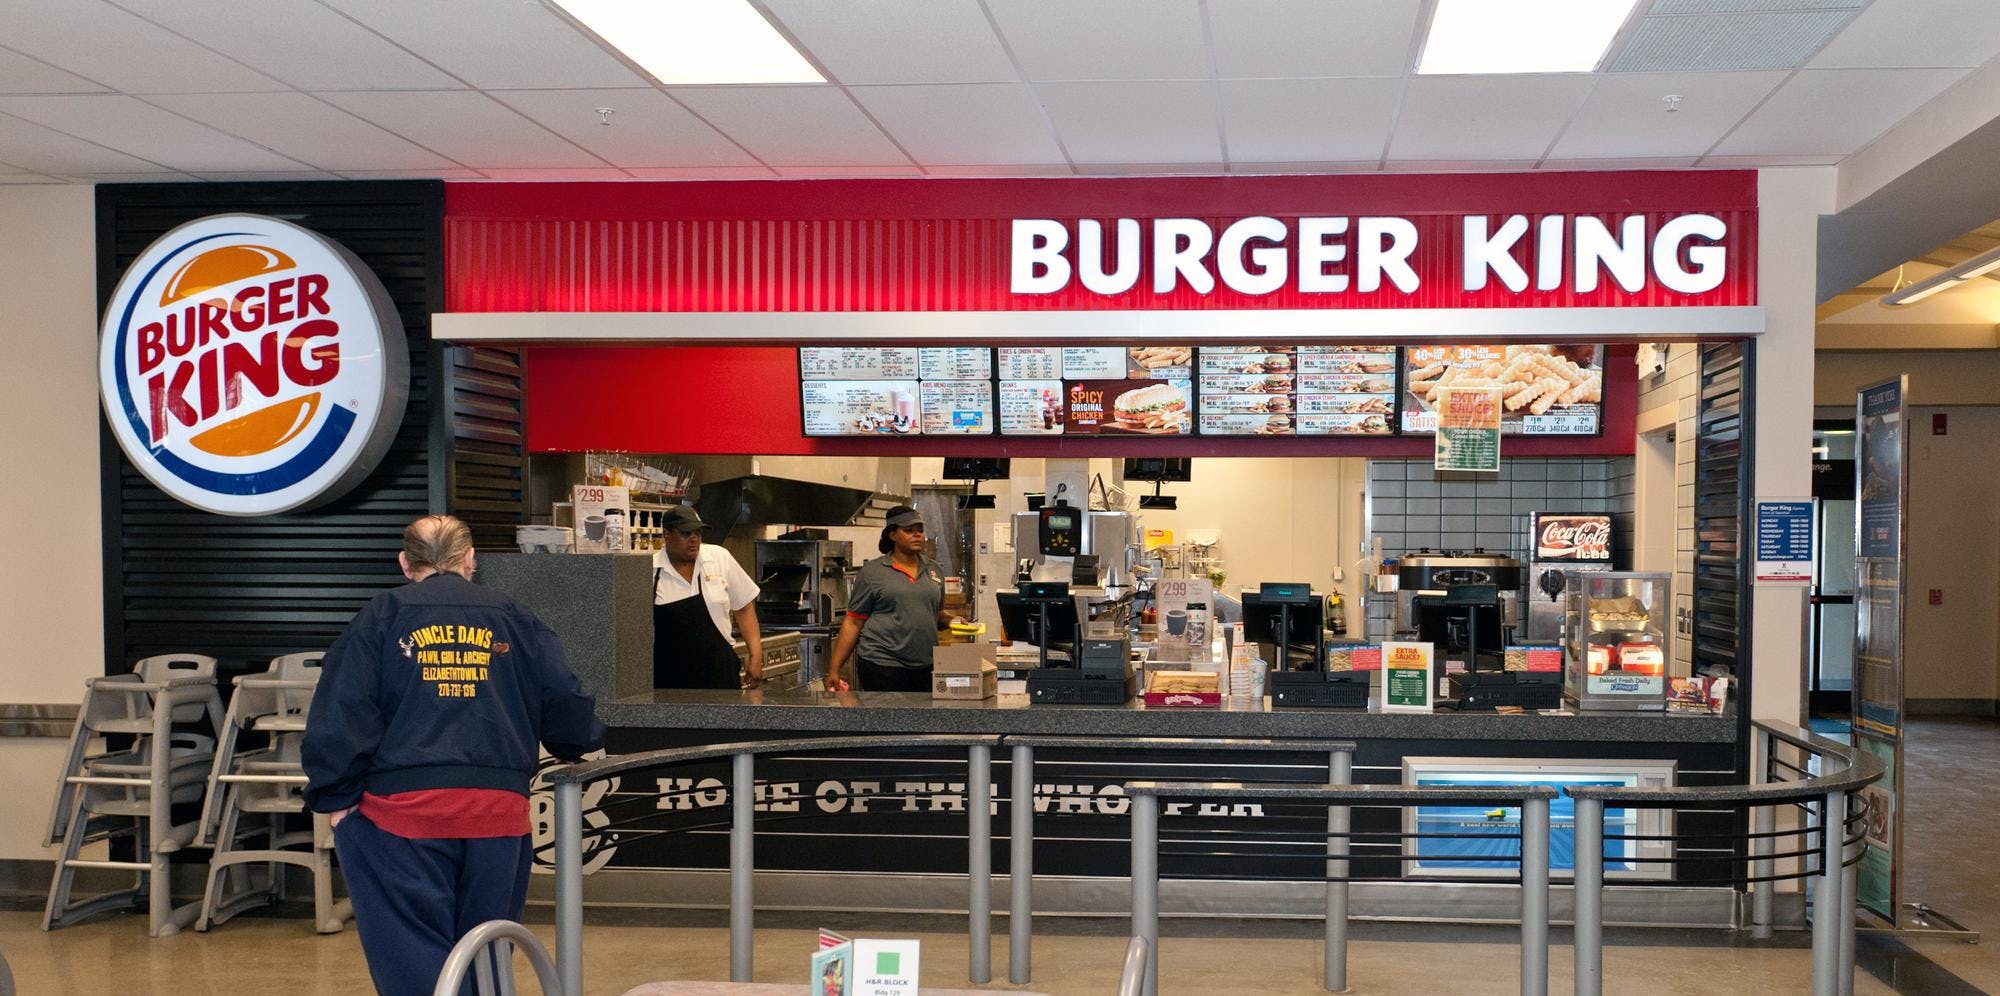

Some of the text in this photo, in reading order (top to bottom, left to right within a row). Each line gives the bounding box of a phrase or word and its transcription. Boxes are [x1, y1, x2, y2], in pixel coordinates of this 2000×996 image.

[1010, 213, 1728, 296] BURGER KING
[137, 273, 330, 376] BURGER
[1200, 355, 1205, 363] 2
[1299, 355, 1303, 363] 7
[147, 319, 340, 444] KING
[1200, 376, 1205, 384] 3
[1298, 375, 1303, 384] 8
[1071, 391, 1104, 404] SPICY
[1200, 396, 1206, 404] 4
[1298, 395, 1303, 404] 9
[1451, 392, 1488, 402] EXTRA
[1071, 403, 1104, 411] ORIGINAL
[1071, 411, 1104, 420] CHICKEN
[1201, 415, 1206, 424] 5
[577, 488, 604, 502] $2.99
[1542, 521, 1611, 546] Coca-Cola
[411, 625, 493, 649] UNCLE DAN'S
[417, 650, 491, 666] PAWN, GUN & ARCHERY
[423, 667, 488, 681] ELIZABETHTOWN, KY
[1636, 677, 1650, 685] Daily
[815, 780, 880, 814] OF
